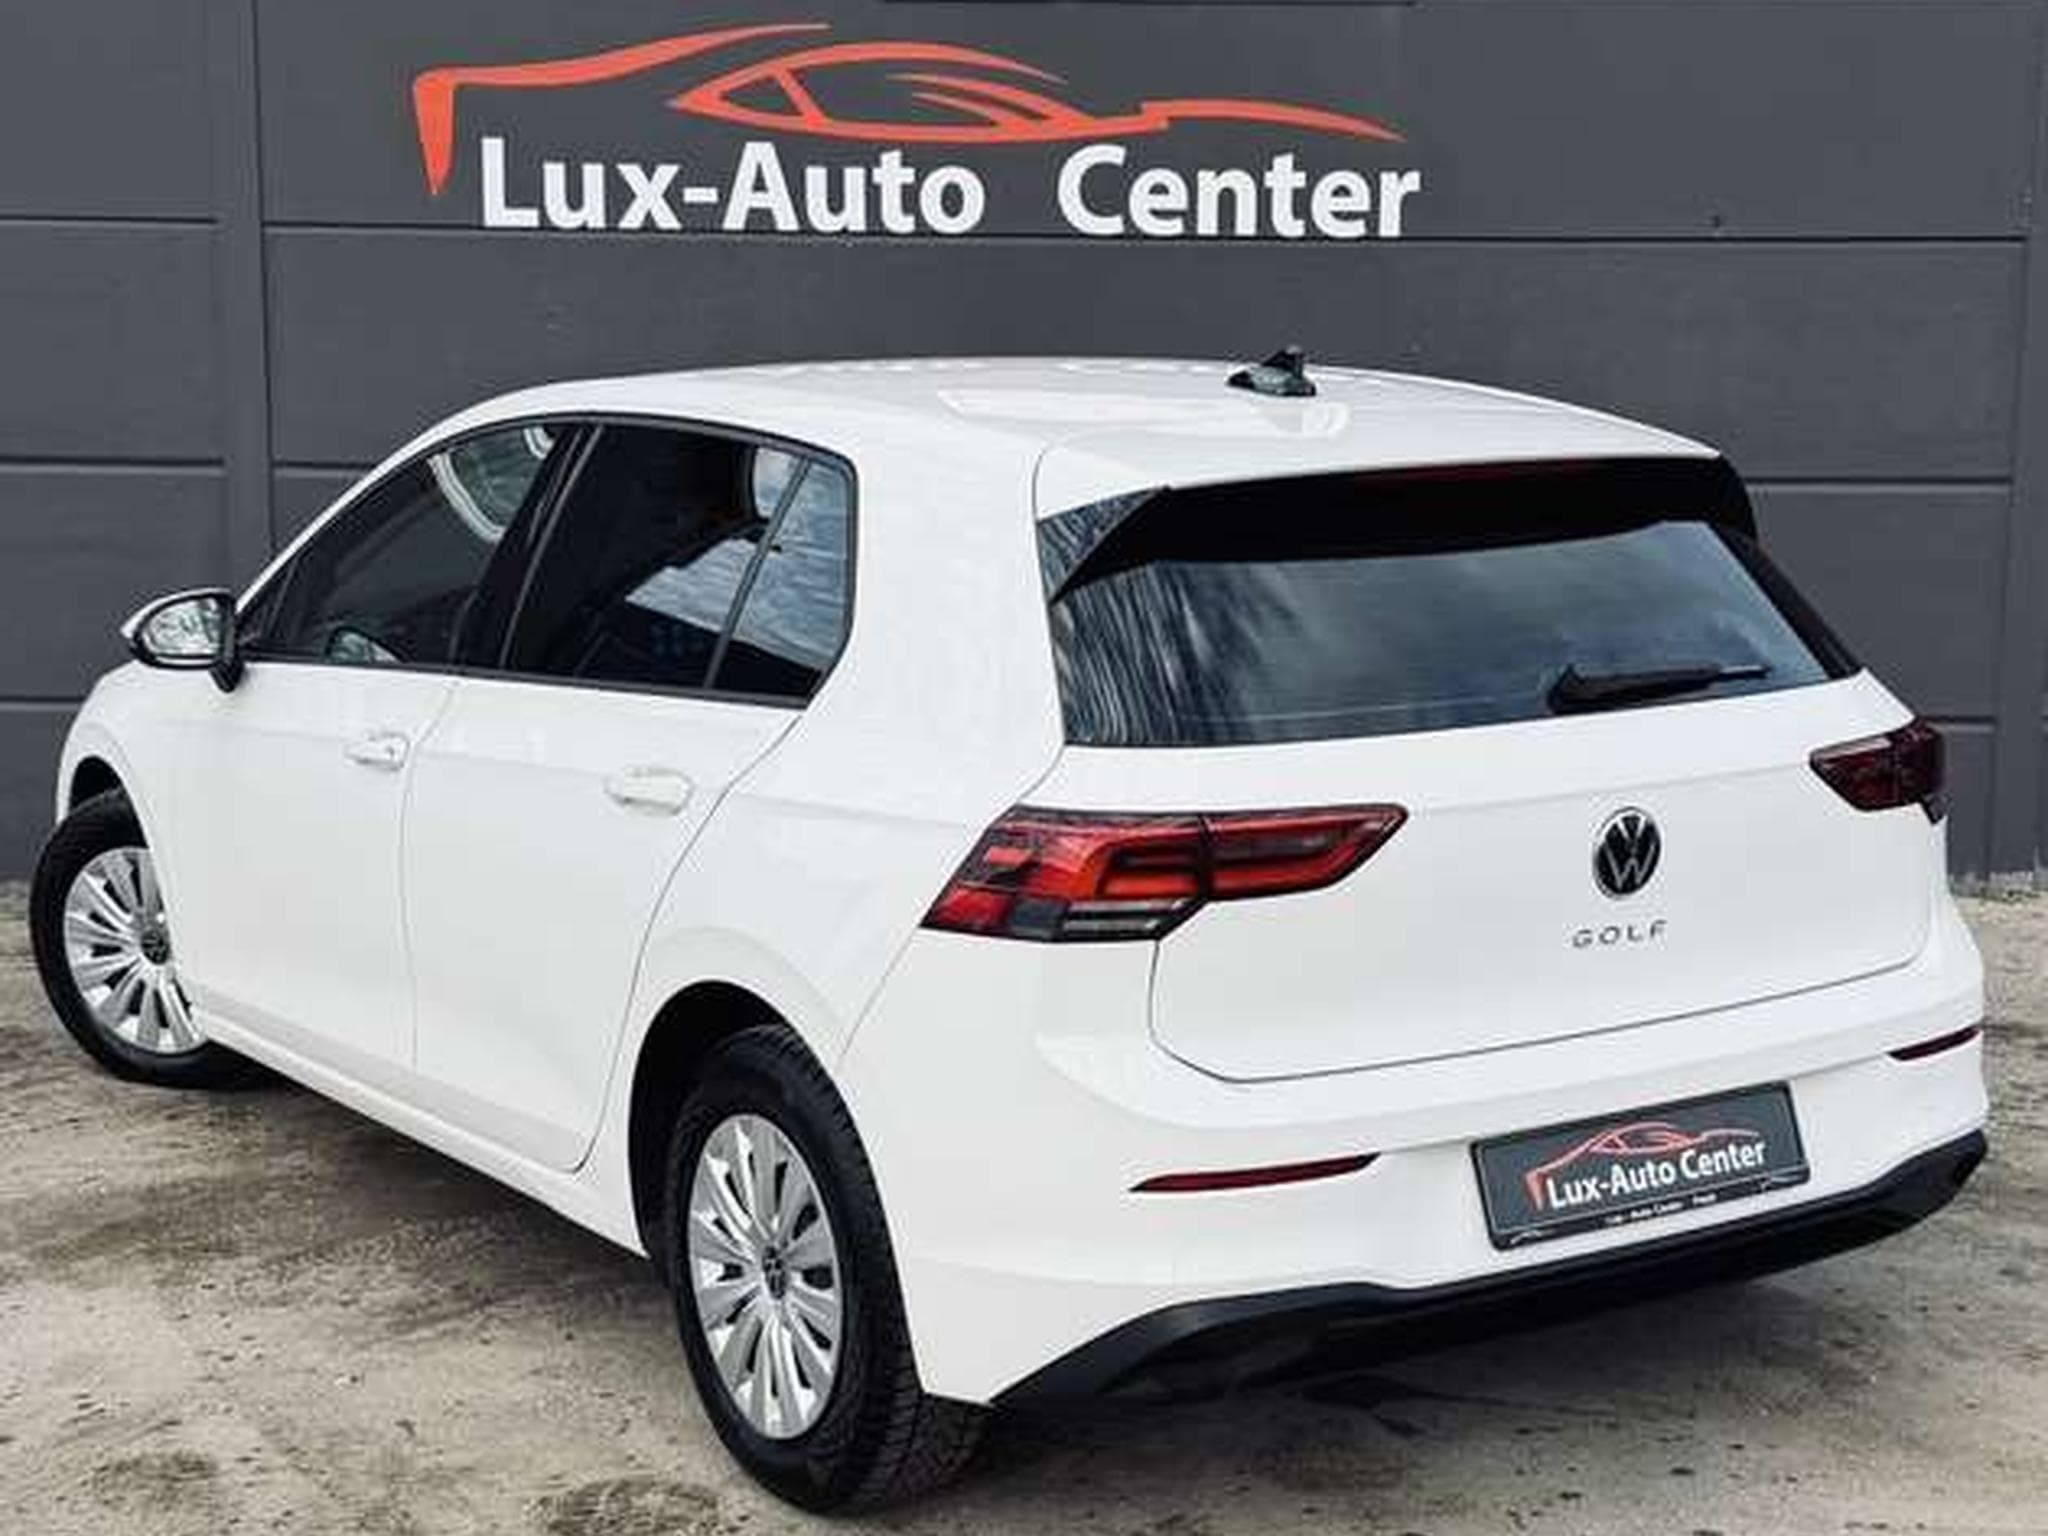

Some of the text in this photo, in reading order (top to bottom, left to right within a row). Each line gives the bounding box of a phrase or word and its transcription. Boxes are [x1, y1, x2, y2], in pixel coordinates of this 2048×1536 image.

[481, 138, 1421, 238] Lux-Auto Center
[1573, 919, 1668, 948] GOLF
[1547, 1142, 1766, 1209] Lux-Auto Center
